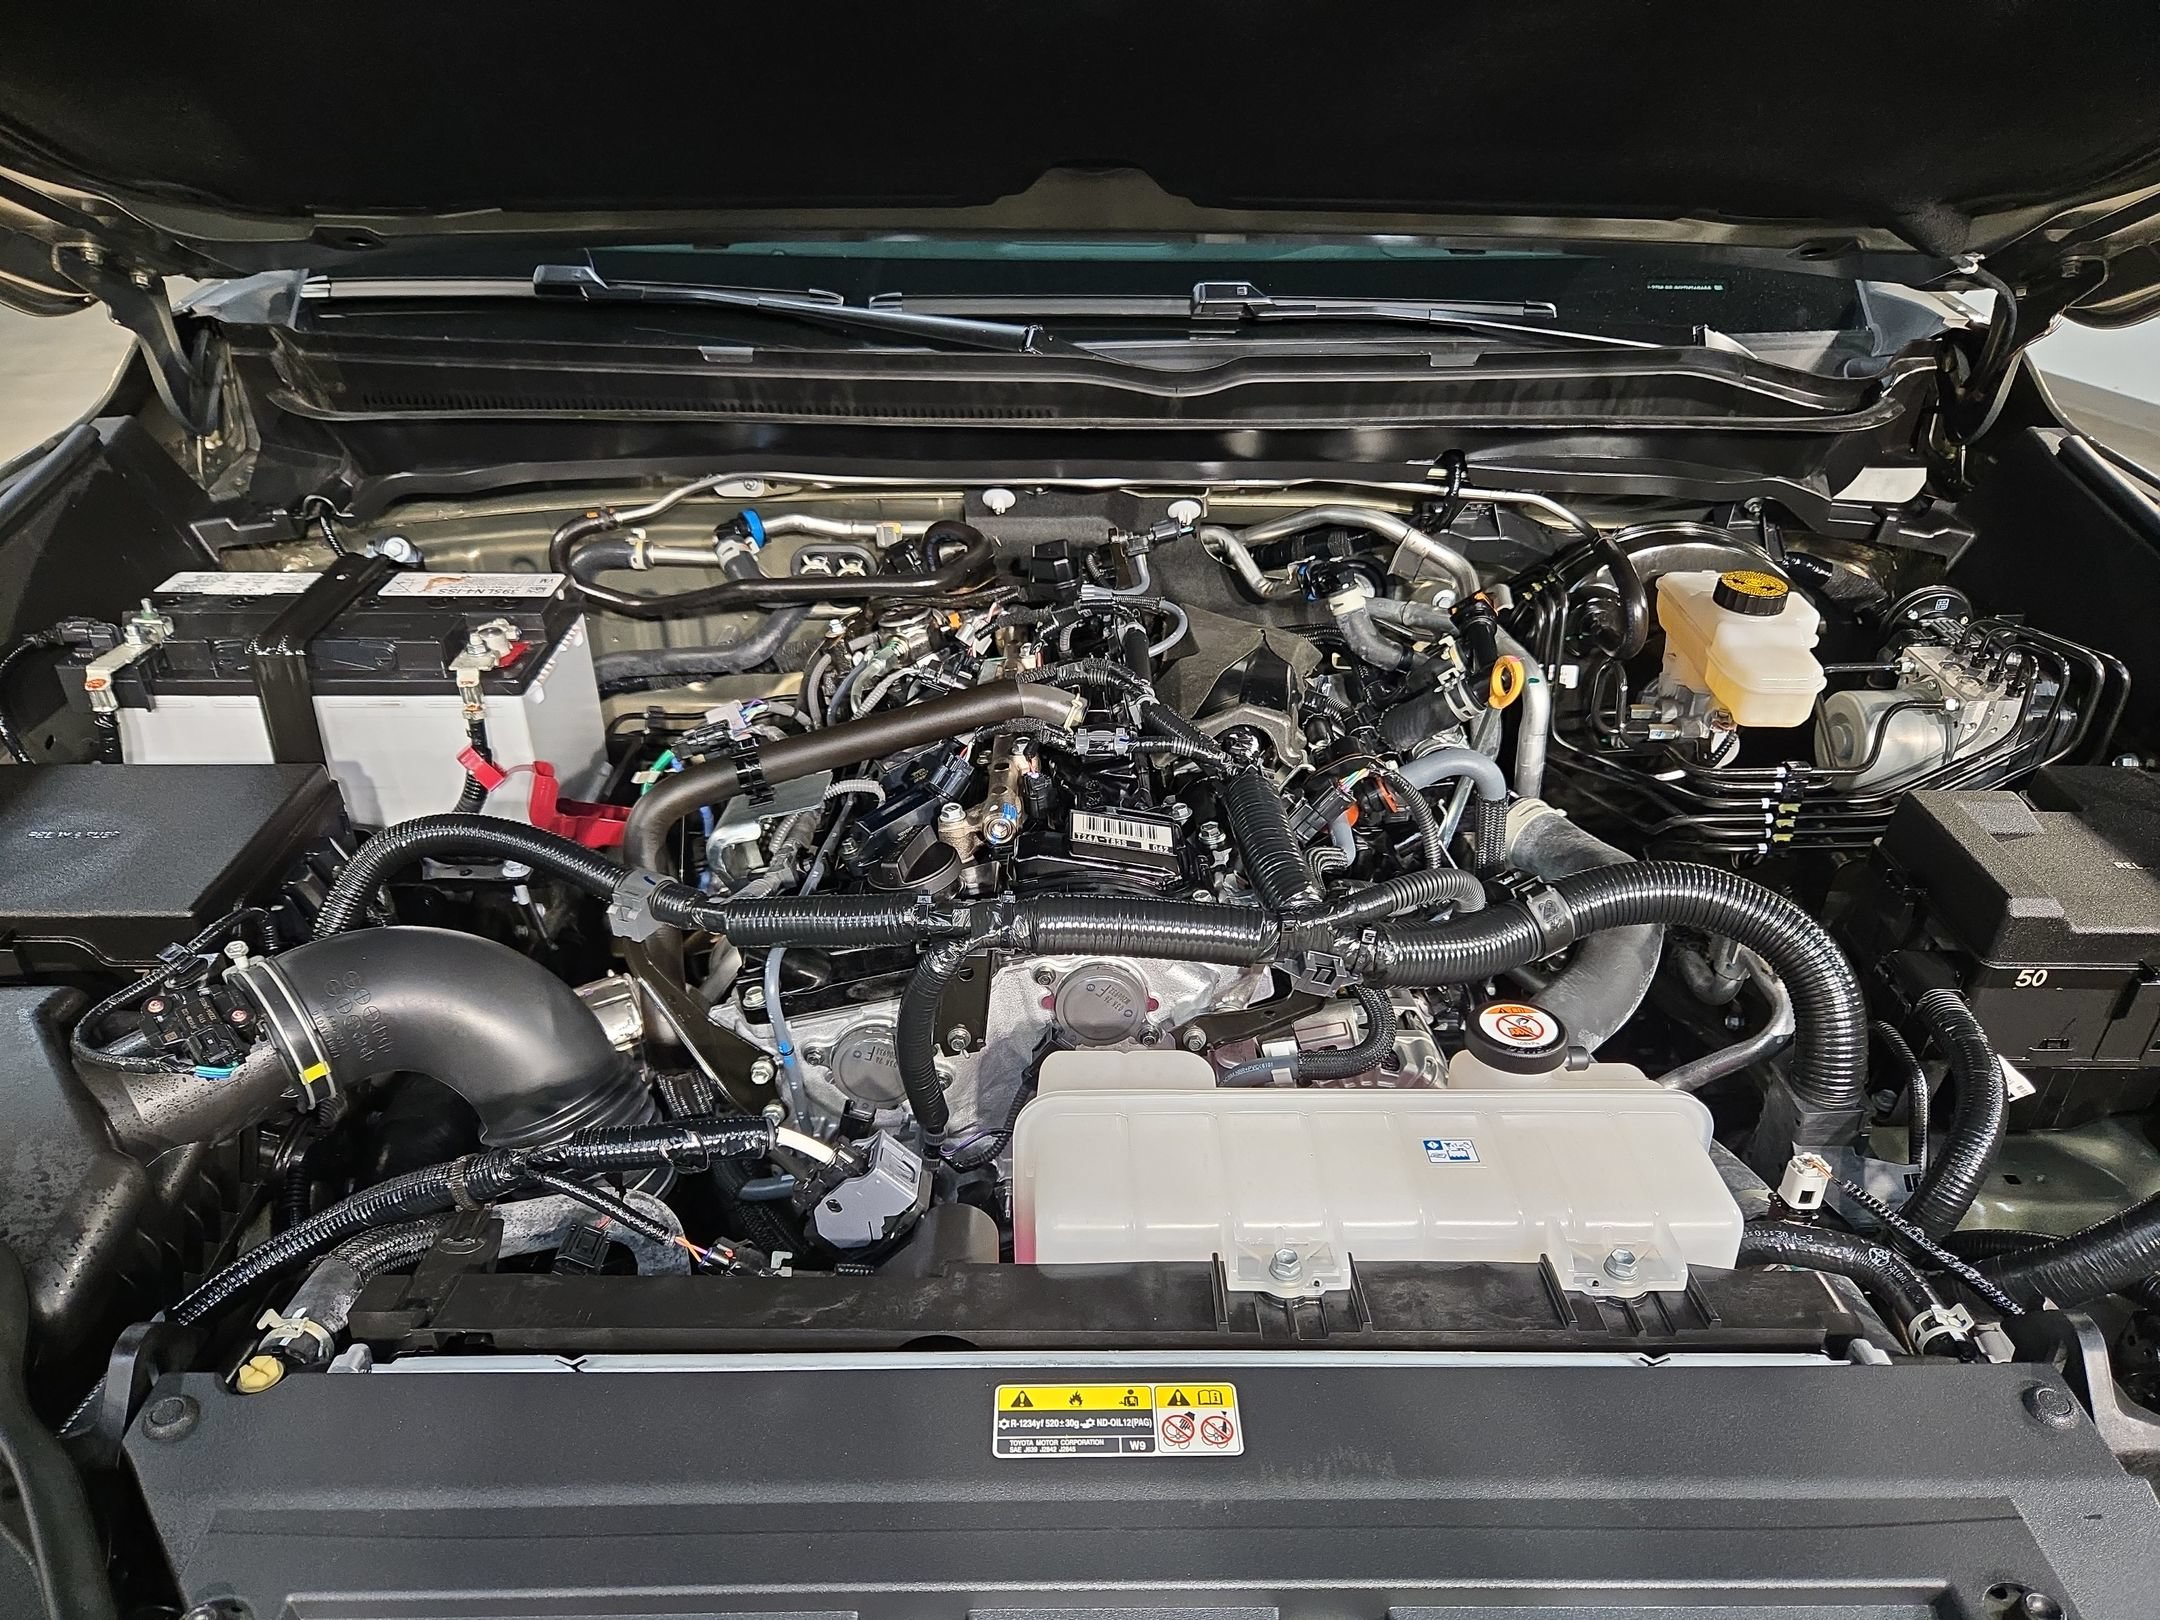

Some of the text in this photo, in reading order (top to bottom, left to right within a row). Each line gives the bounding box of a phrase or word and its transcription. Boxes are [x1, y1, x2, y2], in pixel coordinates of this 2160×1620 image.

[2014, 969, 2048, 987] 50
[1010, 1419, 1044, 1430] R-1234yf
[1096, 1418, 1153, 1429] ND-OIL12(PAG)
[1060, 1438, 1105, 1446] CORPORATION
[1129, 1440, 1146, 1451] W9
